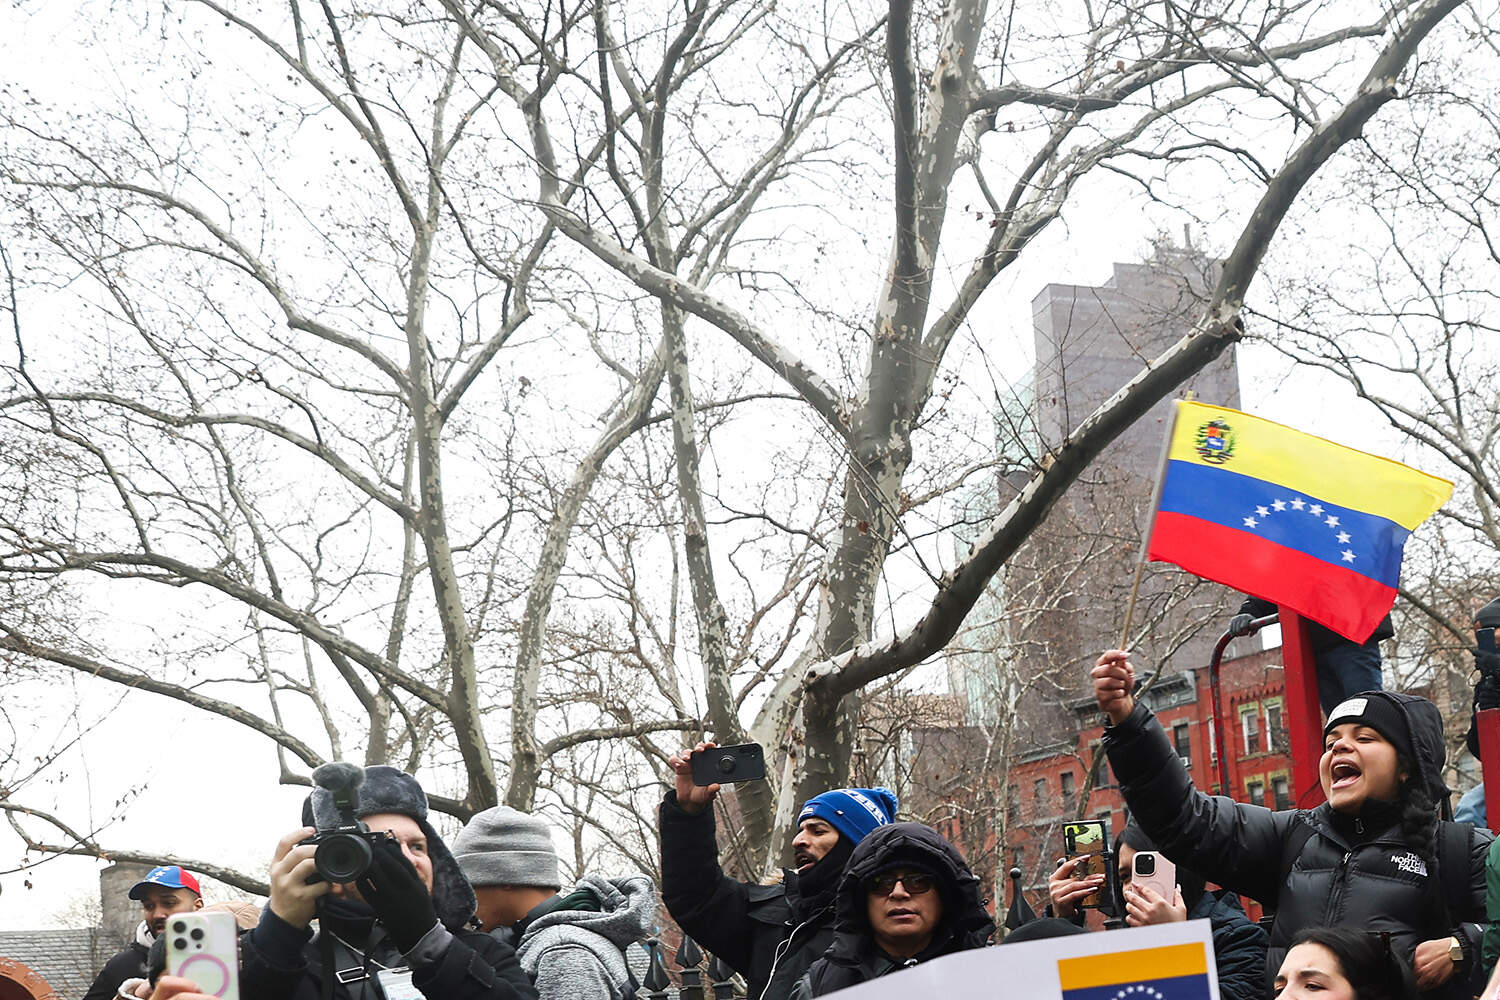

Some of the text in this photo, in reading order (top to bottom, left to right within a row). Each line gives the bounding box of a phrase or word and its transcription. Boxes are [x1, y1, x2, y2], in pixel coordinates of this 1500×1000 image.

[1391, 855, 1422, 868] NORTH
[1406, 851, 1421, 862] THE
[1398, 864, 1421, 873] FACE
